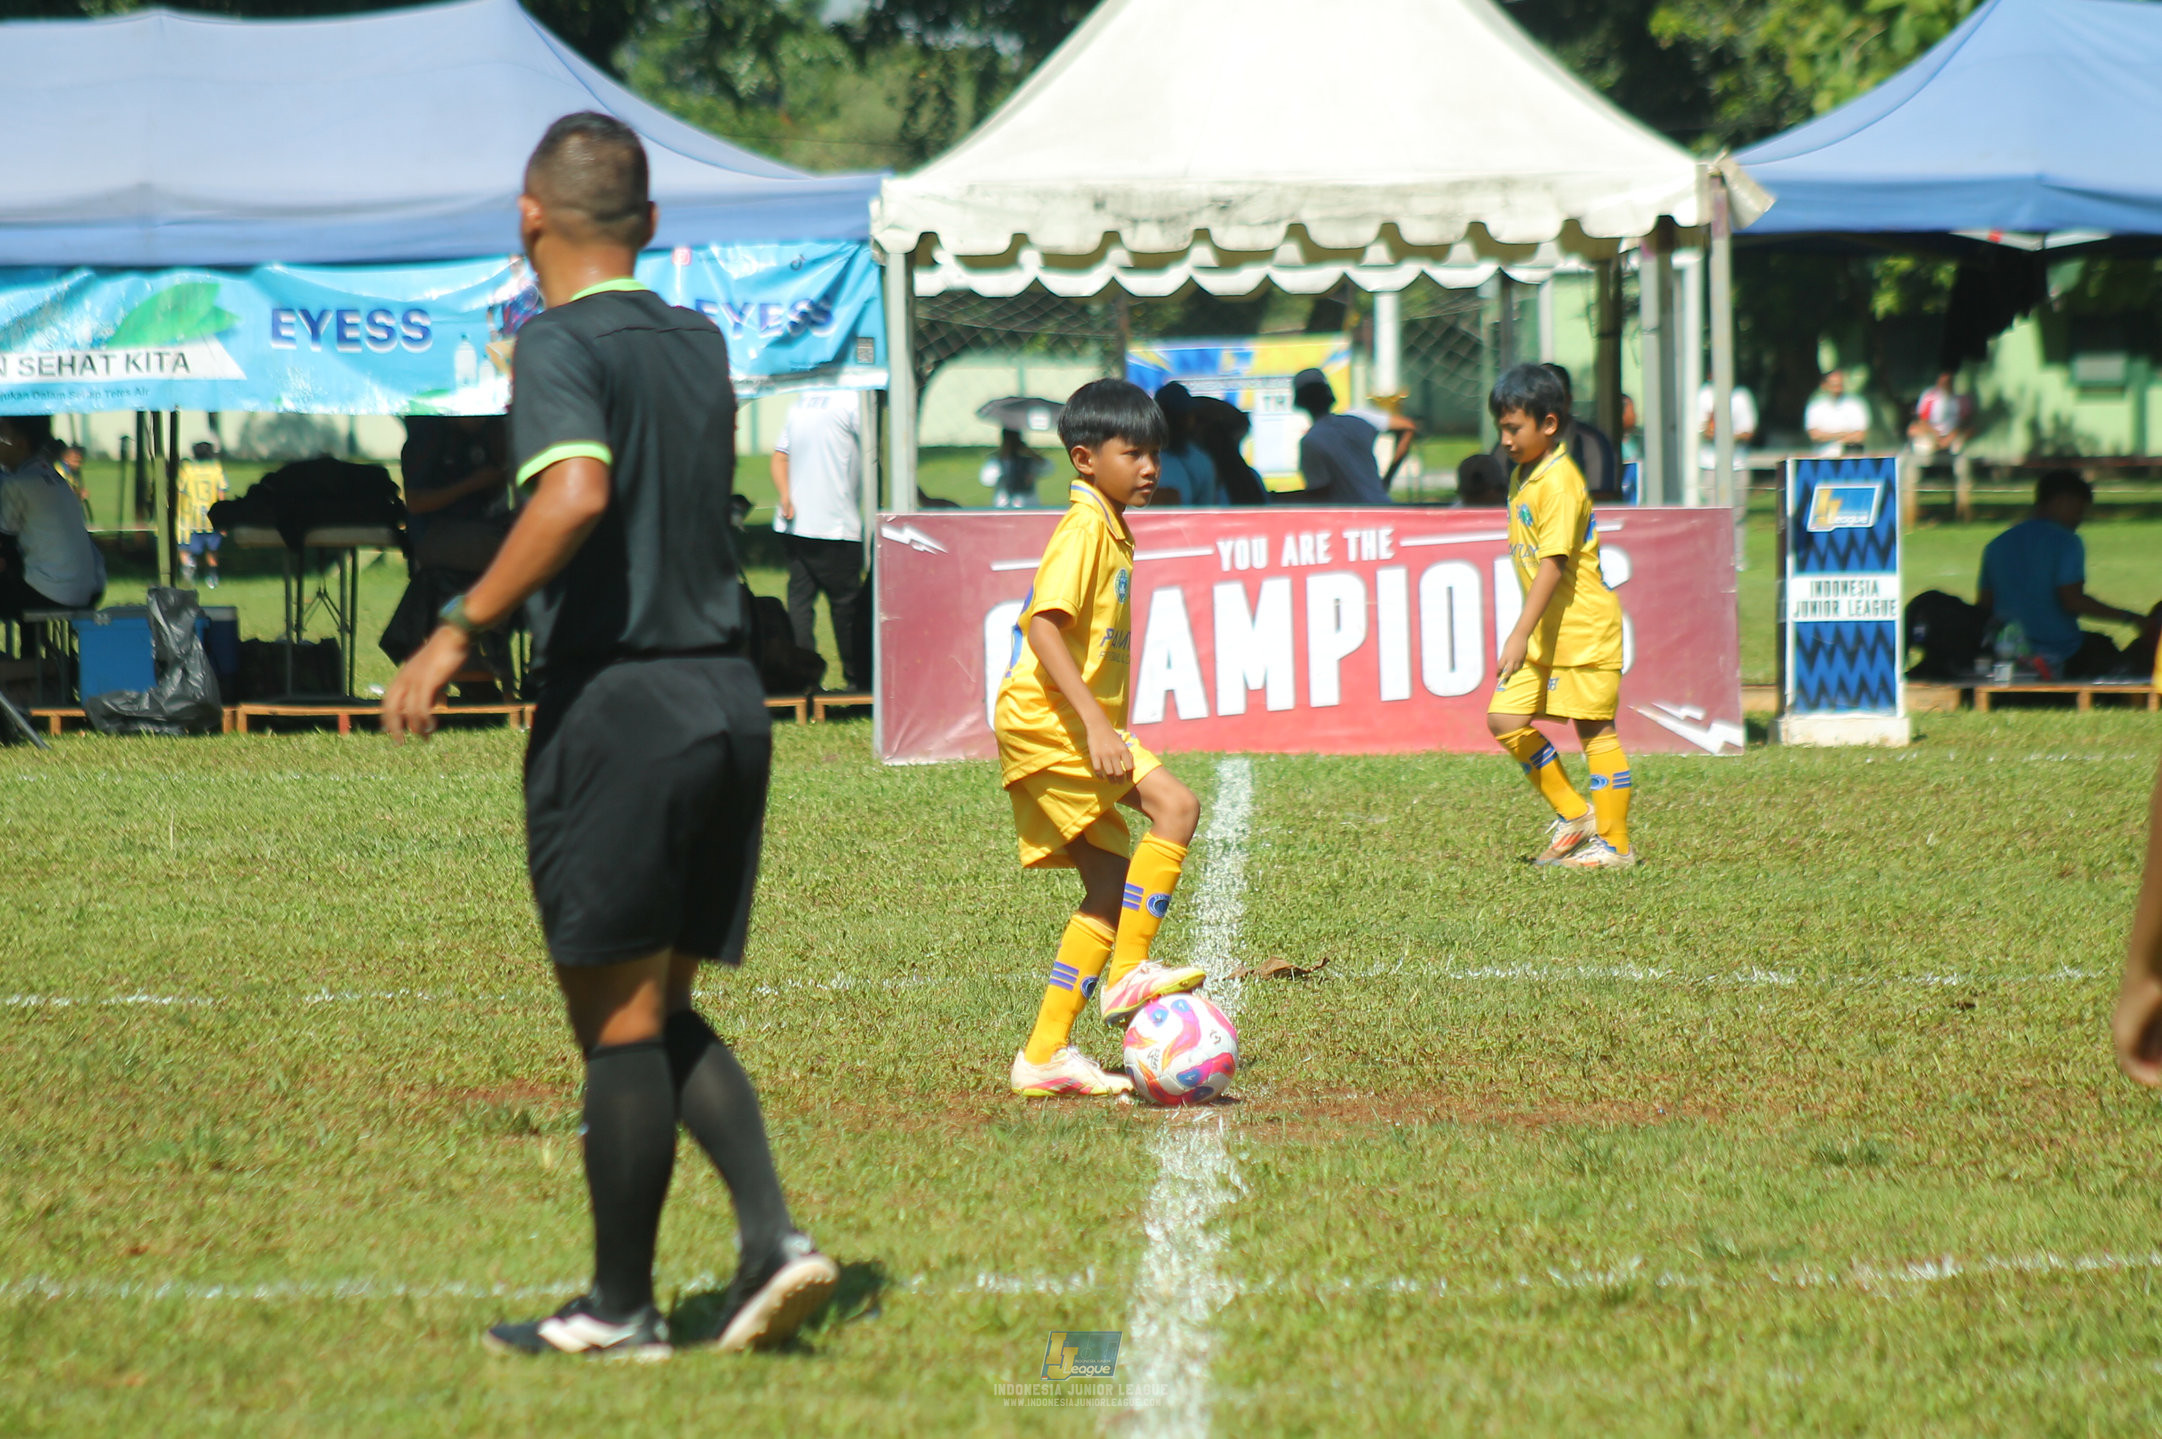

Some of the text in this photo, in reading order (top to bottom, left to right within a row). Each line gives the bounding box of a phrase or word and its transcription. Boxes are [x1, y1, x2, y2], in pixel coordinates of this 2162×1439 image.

[271, 308, 433, 353] EYESS
[18, 354, 117, 377] SEHAT
[125, 351, 191, 374] KITA
[1216, 525, 1396, 572] YOU ARE THE
[1810, 579, 1880, 598] INDONESIA
[1793, 599, 1897, 618] JUNIOR LEAGUE
[984, 545, 1635, 731] AMPIO
